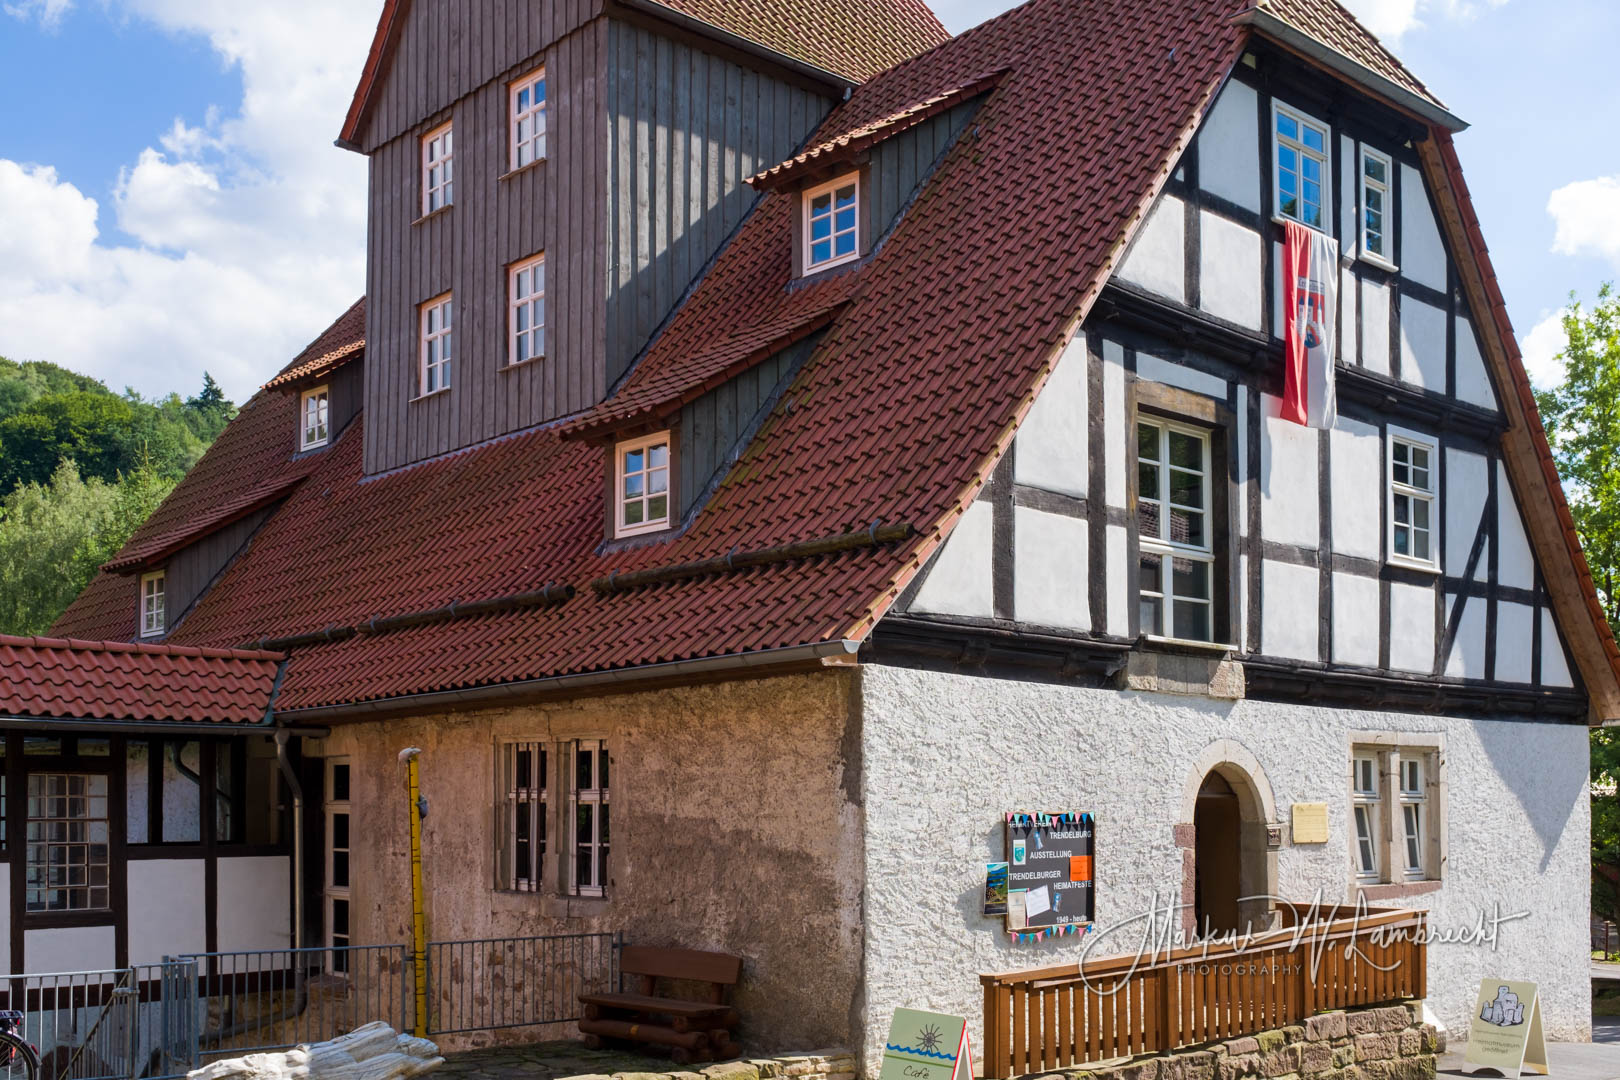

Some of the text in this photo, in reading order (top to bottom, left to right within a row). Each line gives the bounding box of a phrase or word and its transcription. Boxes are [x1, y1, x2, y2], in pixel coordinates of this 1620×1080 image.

[1050, 831, 1091, 839] TRENDELBURG
[1030, 850, 1072, 859] AUSSTELLUNG
[1009, 871, 1061, 880] TRENDELBURGER
[1054, 880, 1092, 889] HEIMATFESTE
[1056, 915, 1068, 923] 1949
[1072, 914, 1087, 922] heute
[903, 1065, 930, 1080] Café
